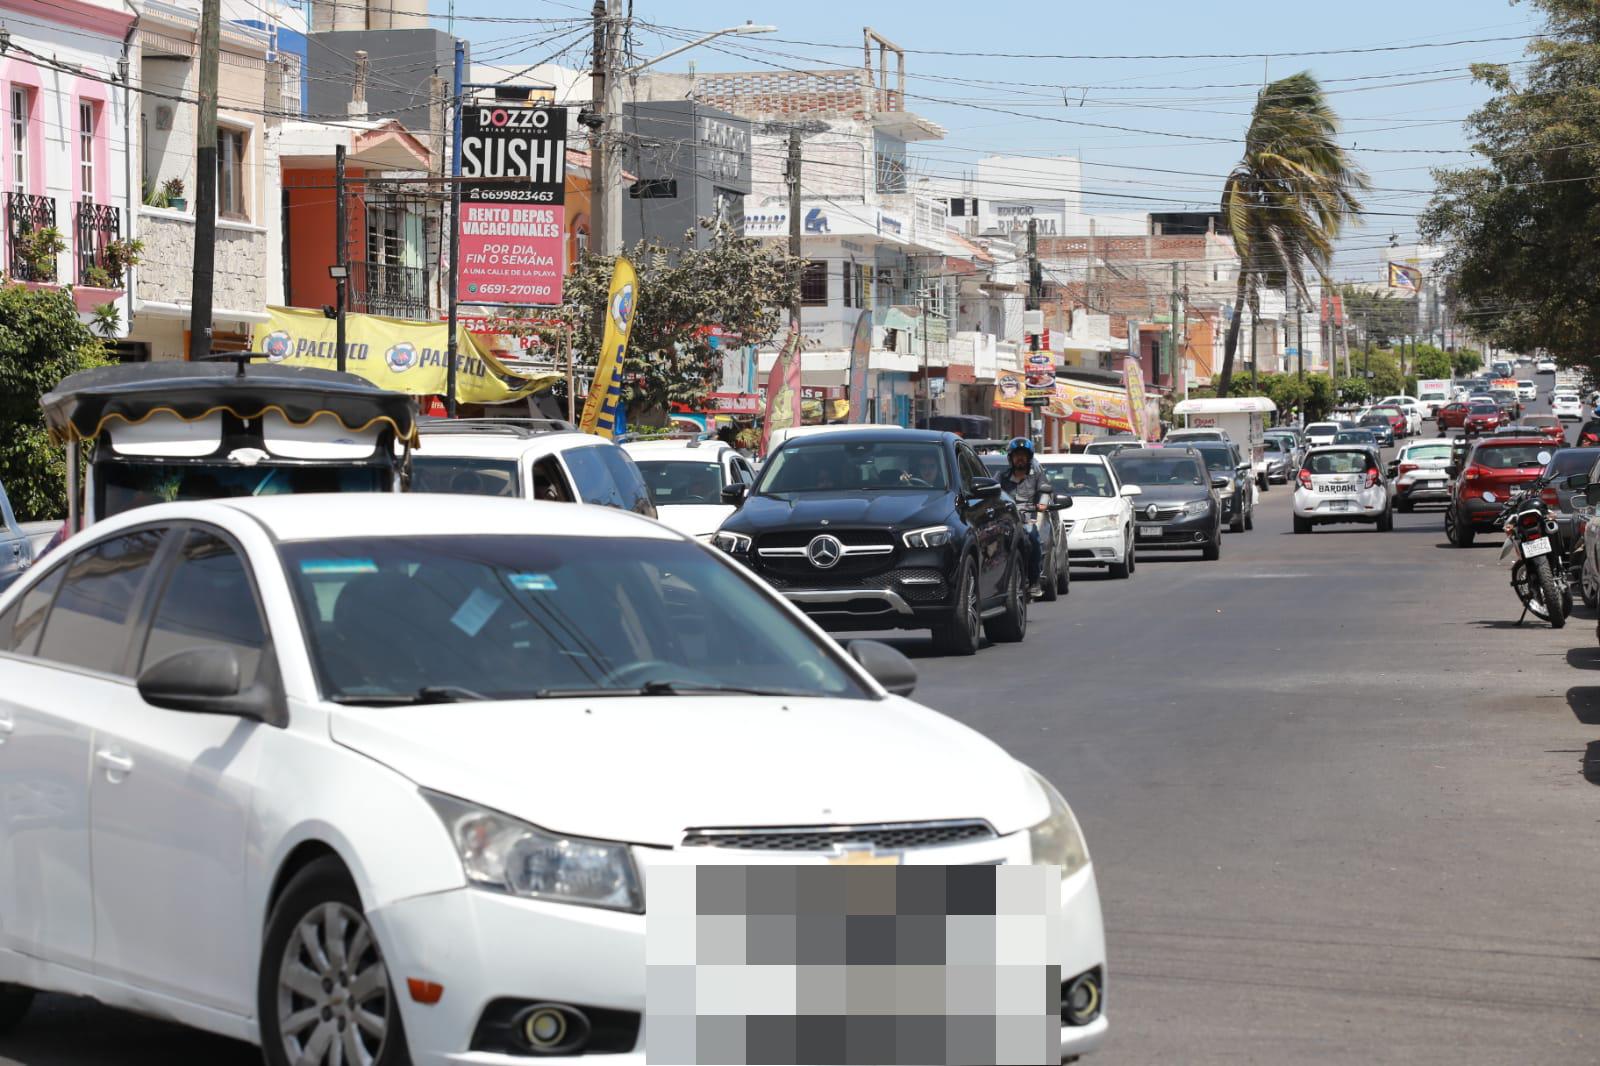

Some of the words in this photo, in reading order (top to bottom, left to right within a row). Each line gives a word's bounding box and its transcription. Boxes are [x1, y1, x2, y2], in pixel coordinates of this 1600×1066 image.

[480, 109, 549, 128] DOZZO
[462, 137, 564, 183] SUSHI
[481, 190, 553, 201] 6699823463
[469, 208, 510, 222] RENTO
[512, 209, 554, 223] DEPAS
[462, 222, 559, 237] VACACIONALES
[483, 244, 509, 254] POR
[466, 254, 486, 263] FIN
[489, 254, 499, 264] O
[480, 284, 551, 295] 6691-270180
[419, 348, 486, 377] PACFICO
[1319, 485, 1357, 493] BARDAHL
